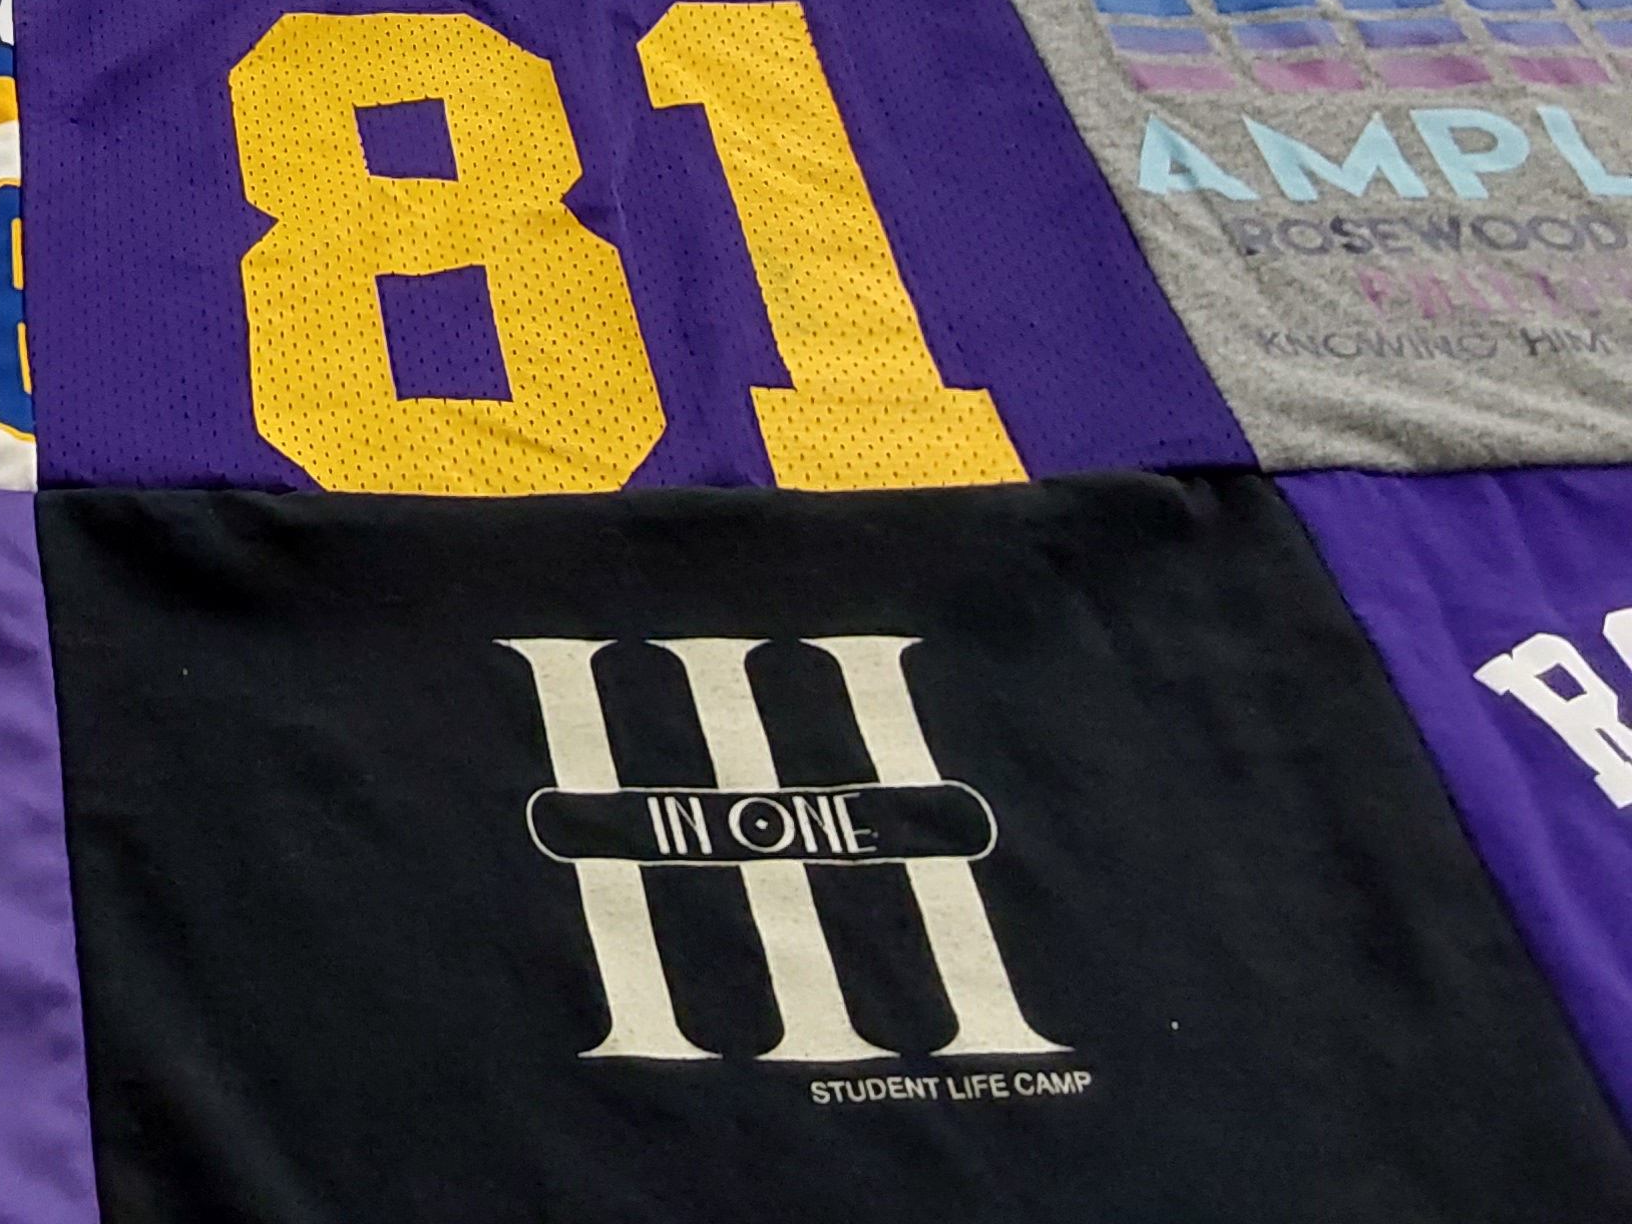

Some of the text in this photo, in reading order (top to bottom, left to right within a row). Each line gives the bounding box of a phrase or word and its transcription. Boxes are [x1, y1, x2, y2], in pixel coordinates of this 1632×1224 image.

[228, 0, 1033, 497] 81
[1232, 212, 1630, 258] ROSEWOOD
[647, 792, 880, 856] IN ONE
[810, 1070, 1093, 1106] STUDENT LIFE CAMP
